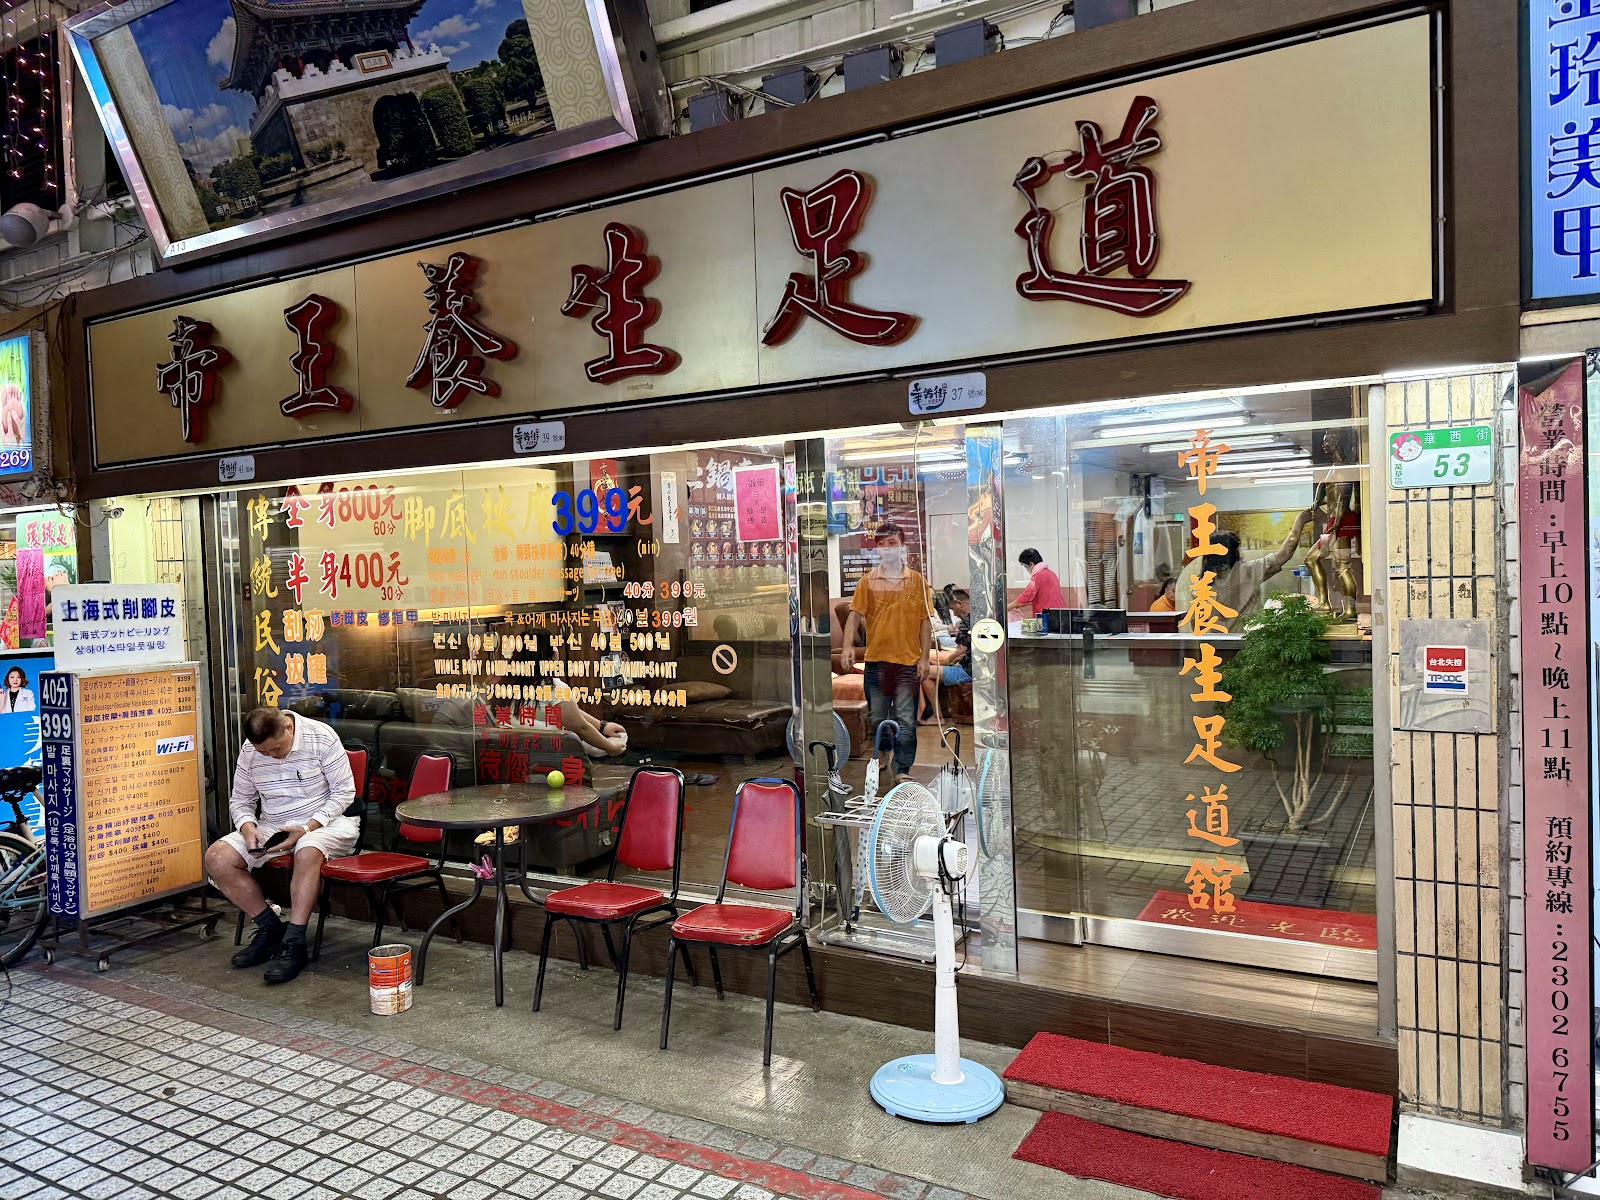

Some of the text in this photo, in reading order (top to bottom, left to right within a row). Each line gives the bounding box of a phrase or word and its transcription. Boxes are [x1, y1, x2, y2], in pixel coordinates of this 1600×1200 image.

[170, 241, 186, 254] A13
[156, 95, 1192, 443] 帝王養生足道
[951, 387, 963, 401] 37
[542, 432, 550, 444] 39
[1424, 428, 1489, 445] 華西街
[1433, 452, 1471, 478] 53
[1394, 463, 1403, 485] 萬華區
[373, 519, 396, 536] 60分
[637, 538, 661, 558] (min)
[494, 569, 507, 580] min
[549, 563, 583, 582] massage
[381, 585, 404, 601] 30分
[624, 580, 706, 599] 40分 399元
[61, 597, 176, 622] 上海式削腳皮
[377, 609, 419, 627] 修指甲
[550, 609, 590, 627] 마사지는
[651, 606, 698, 629] 399원
[282, 608, 325, 642] 刮痧
[433, 633, 461, 650] 전신
[591, 632, 622, 651] 40분
[629, 631, 671, 651] 500원
[285, 652, 327, 685] 拔罐
[434, 659, 460, 675] WHOLE
[462, 659, 483, 676] BODY
[539, 660, 565, 677] UPPER
[568, 660, 591, 677] BODY
[593, 660, 616, 677] PART
[620, 661, 678, 679] 40MIN=500NT
[1429, 658, 1463, 667] 台北失控
[177, 675, 191, 683] $399
[1176, 428, 1245, 915] 帝王養生足道館
[42, 676, 68, 708] 40分
[84, 703, 94, 712] Foot
[178, 696, 192, 704] $399
[157, 706, 172, 715] 40分
[473, 701, 563, 730] 營業時間
[42, 712, 72, 739] 399
[109, 722, 136, 731] マッサージ
[98, 733, 126, 743] マッサージ
[121, 742, 136, 750] $400
[156, 740, 189, 755] Wi-Fi
[131, 758, 147, 767] $400
[104, 775, 118, 785] 오일
[158, 810, 174, 818] 60分
[177, 806, 194, 815] $800
[88, 829, 122, 842] 半身推拿
[142, 831, 161, 840] $400
[108, 847, 128, 856] $400
[151, 837, 169, 847] $400
[116, 858, 131, 866] Aroma
[89, 871, 113, 881] Half-body
[113, 865, 135, 875] Massage
[89, 881, 103, 889] Foot
[128, 870, 152, 880] Removal
[146, 876, 160, 885] $400
[90, 897, 113, 908] Chinese
[141, 886, 155, 895] $400
[1552, 1046, 1570, 1142] 6755
